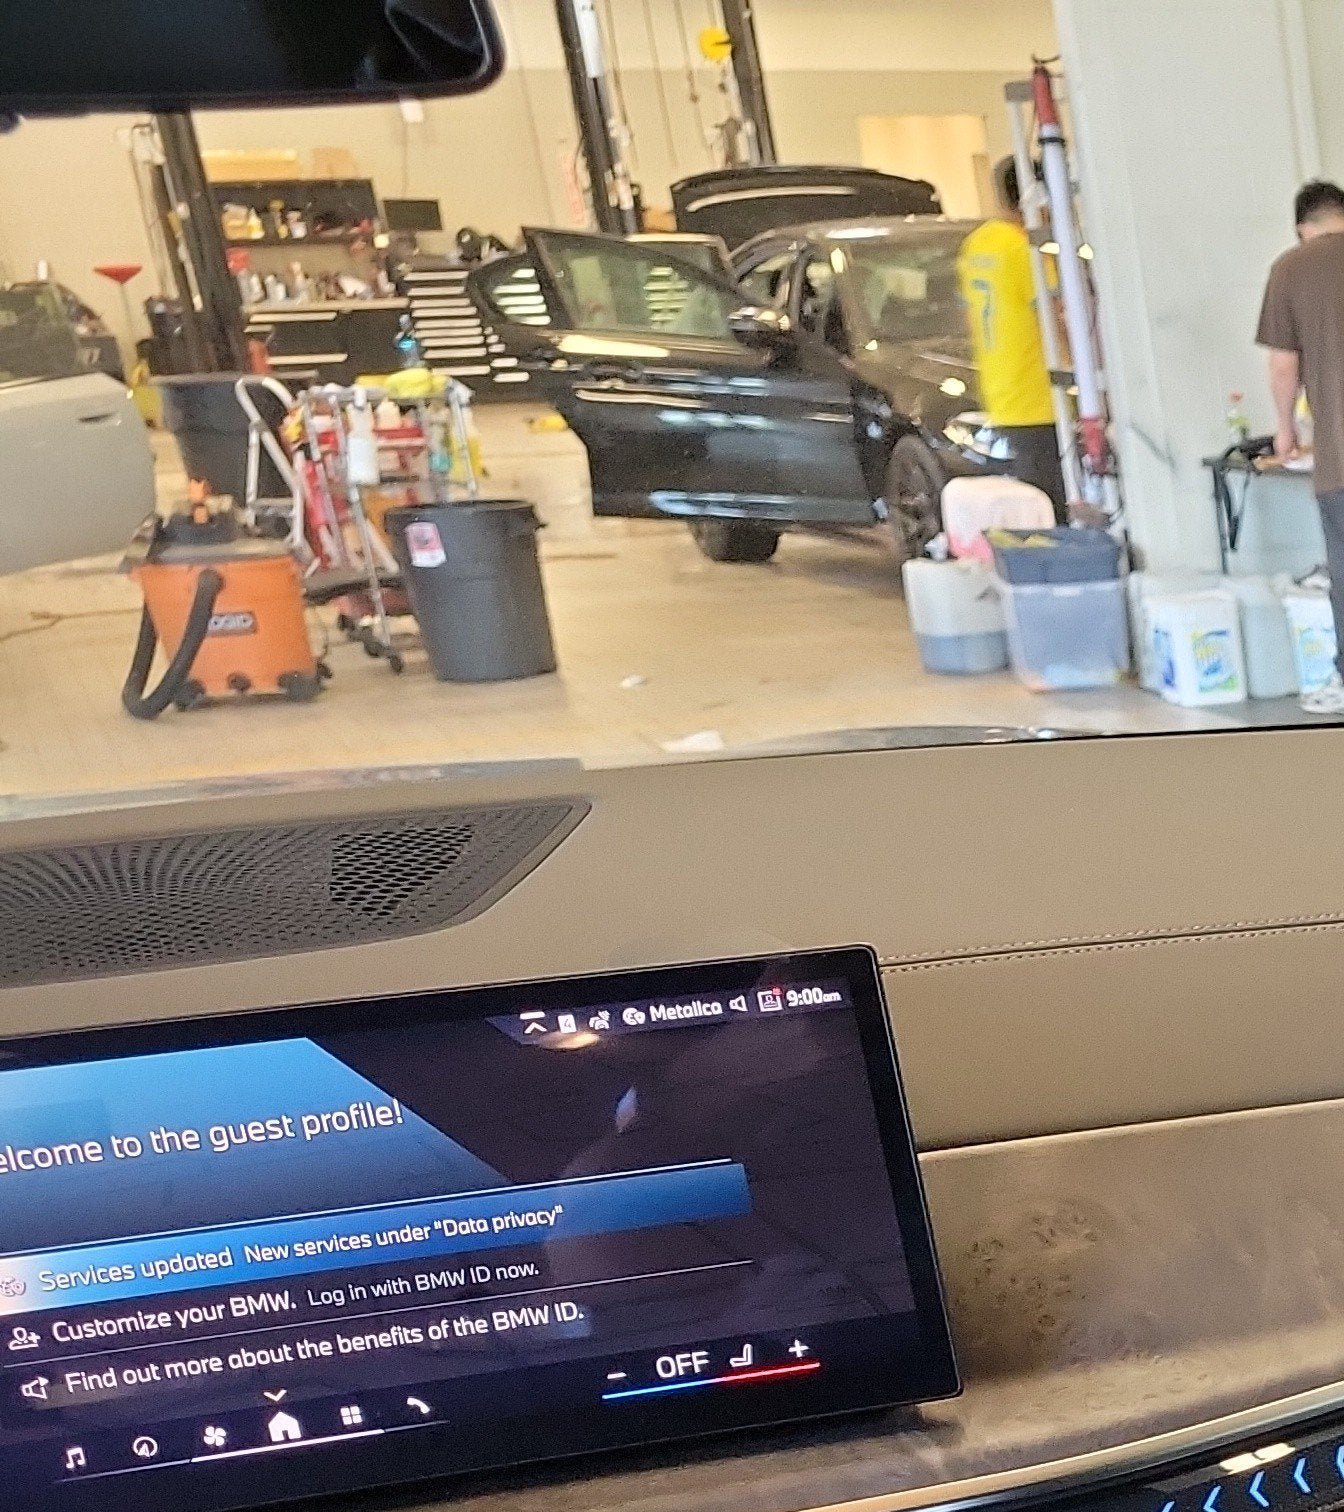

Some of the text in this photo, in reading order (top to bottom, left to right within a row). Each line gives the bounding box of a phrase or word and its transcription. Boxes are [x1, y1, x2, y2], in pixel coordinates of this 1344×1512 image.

[0, 1098, 404, 1174] elcome to the guest profile!
[38, 1205, 564, 1292] Services updated New services under "Data privacy"
[52, 1262, 540, 1343] Customize your BMW. Log in with BMW ID now.
[64, 1301, 584, 1393] Find out more about the benefits of the BMW ID.
[655, 1350, 710, 1379] OFF
